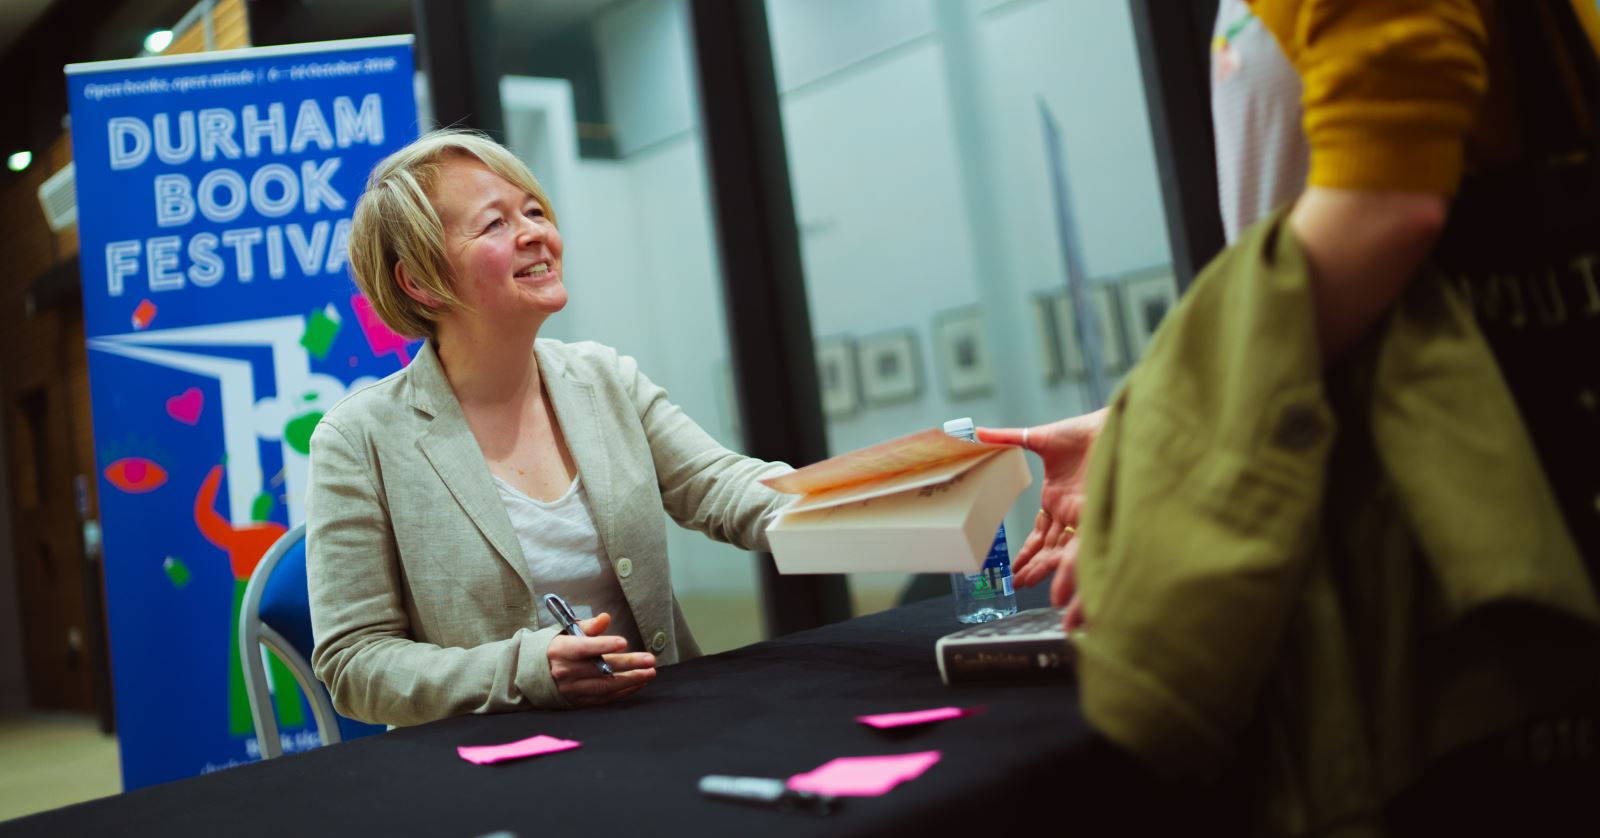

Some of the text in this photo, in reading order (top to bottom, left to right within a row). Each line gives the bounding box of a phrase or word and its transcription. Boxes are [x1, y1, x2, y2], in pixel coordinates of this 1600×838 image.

[107, 93, 384, 170] DURHAM
[154, 157, 347, 228] BOOK
[105, 218, 353, 297] FESTIVA
